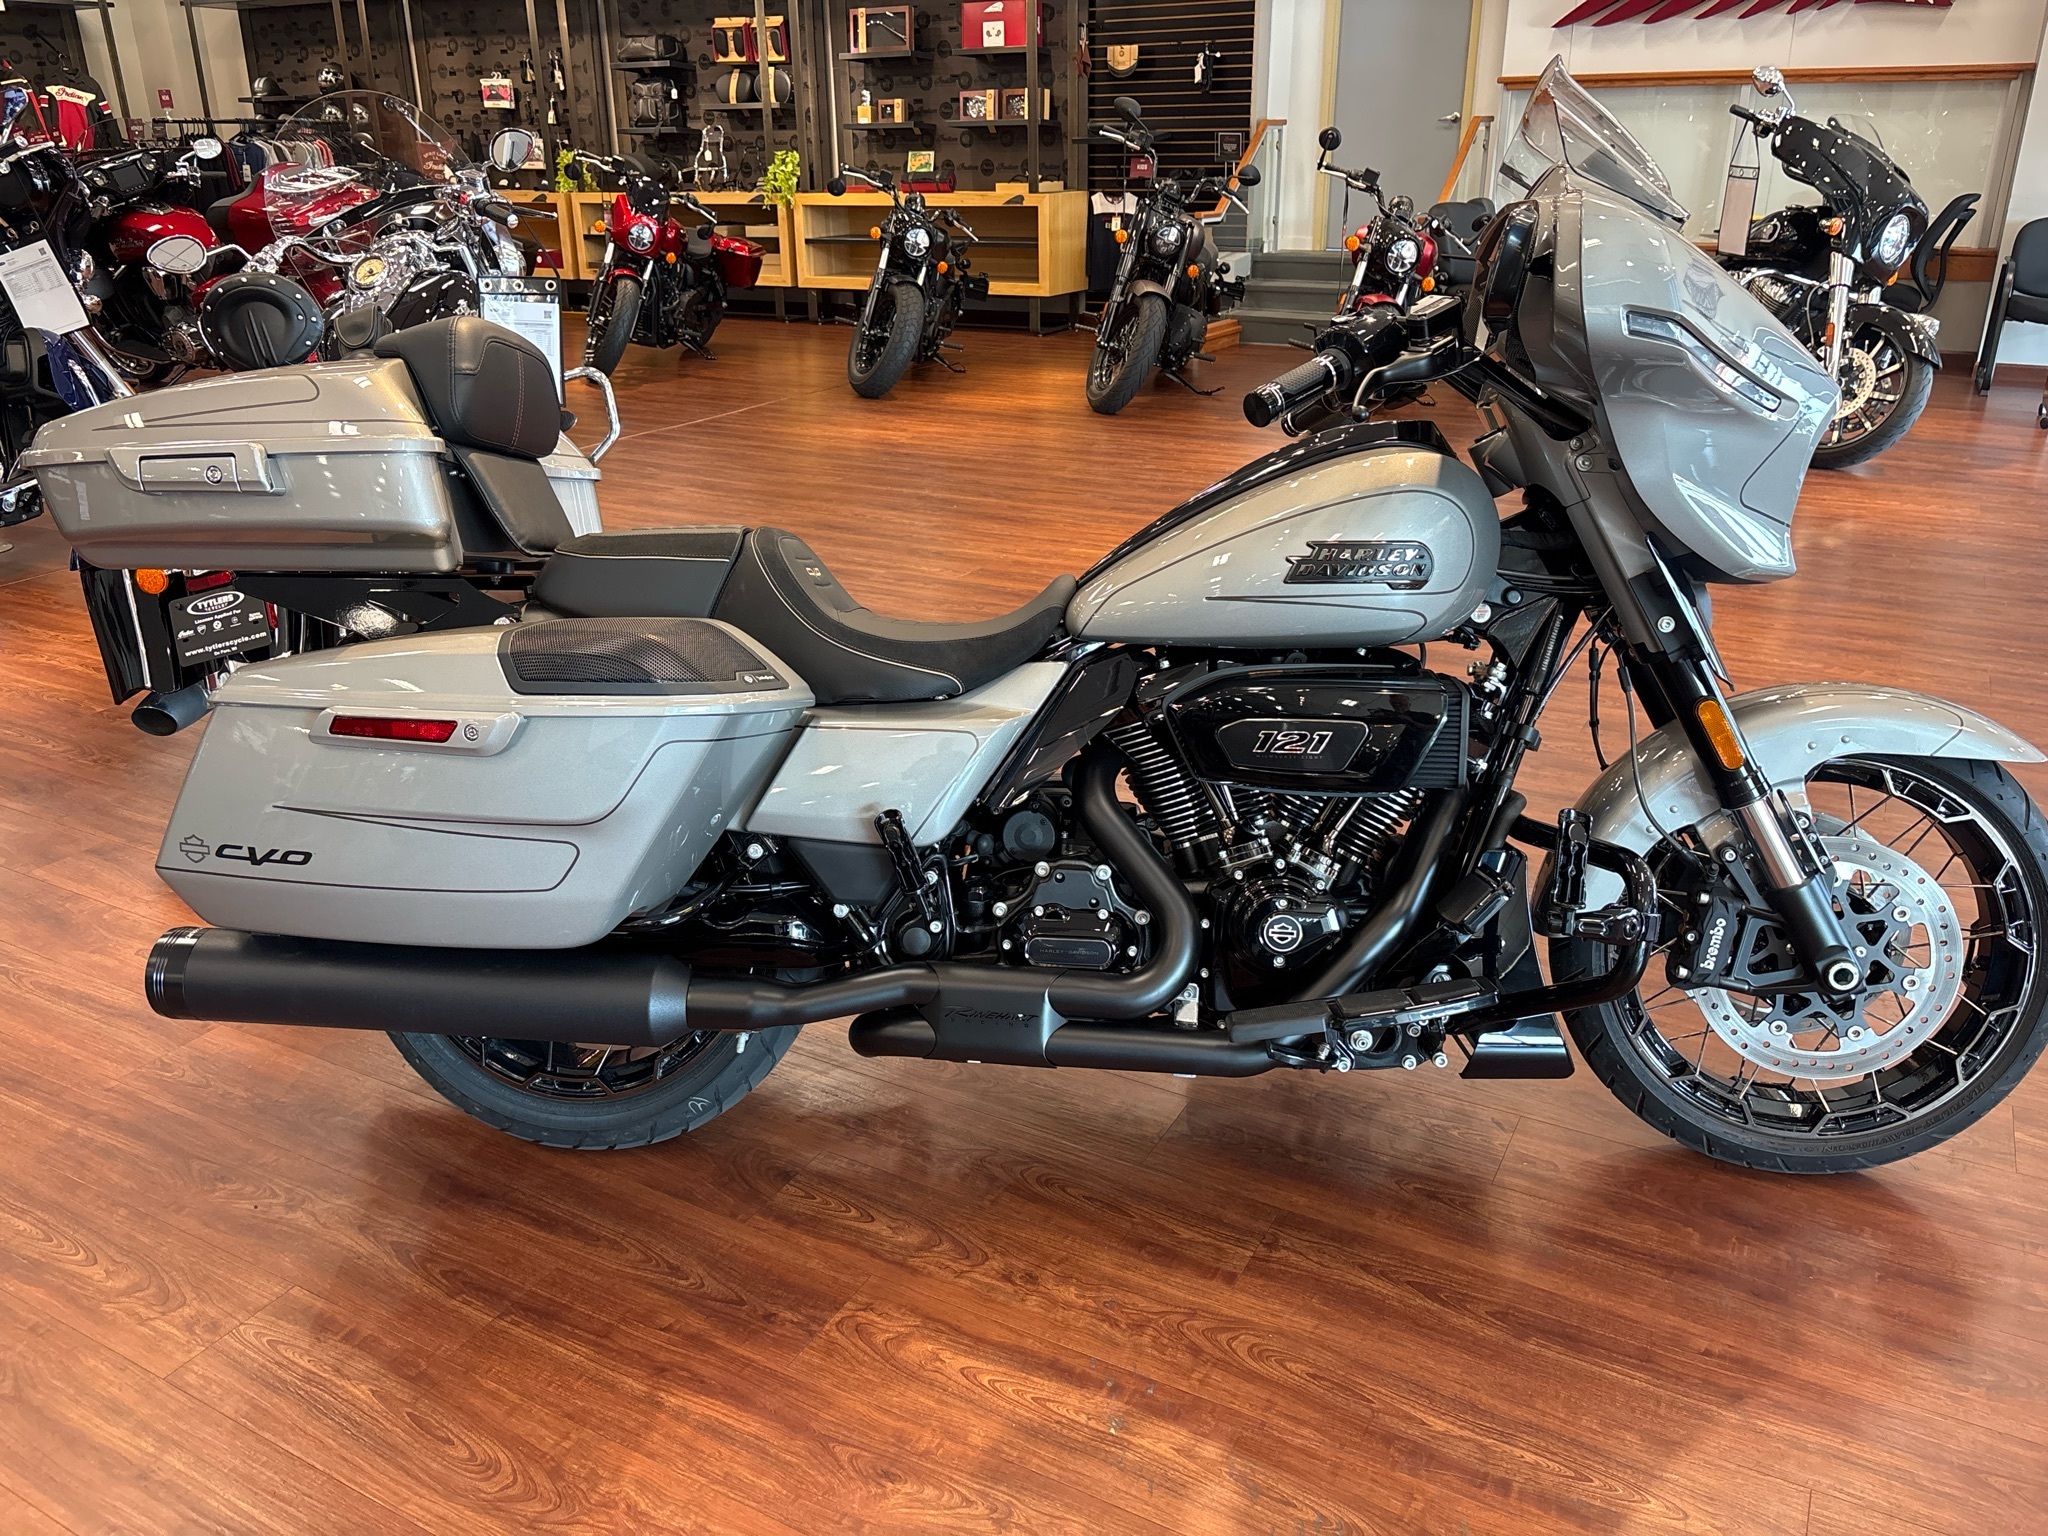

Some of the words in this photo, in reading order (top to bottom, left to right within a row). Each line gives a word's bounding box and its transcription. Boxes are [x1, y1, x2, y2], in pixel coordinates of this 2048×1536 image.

[56, 87, 84, 100] Indian
[1295, 563, 1427, 577] DAVIDSON
[197, 594, 234, 610] TYTLERS
[214, 611, 232, 620] Applied
[185, 631, 267, 656] www.tytlerscycle.com
[1252, 730, 1333, 754] 121
[215, 843, 313, 866] CVO
[1699, 917, 1727, 971] brembo
[943, 1006, 1040, 1023] RINEHART
